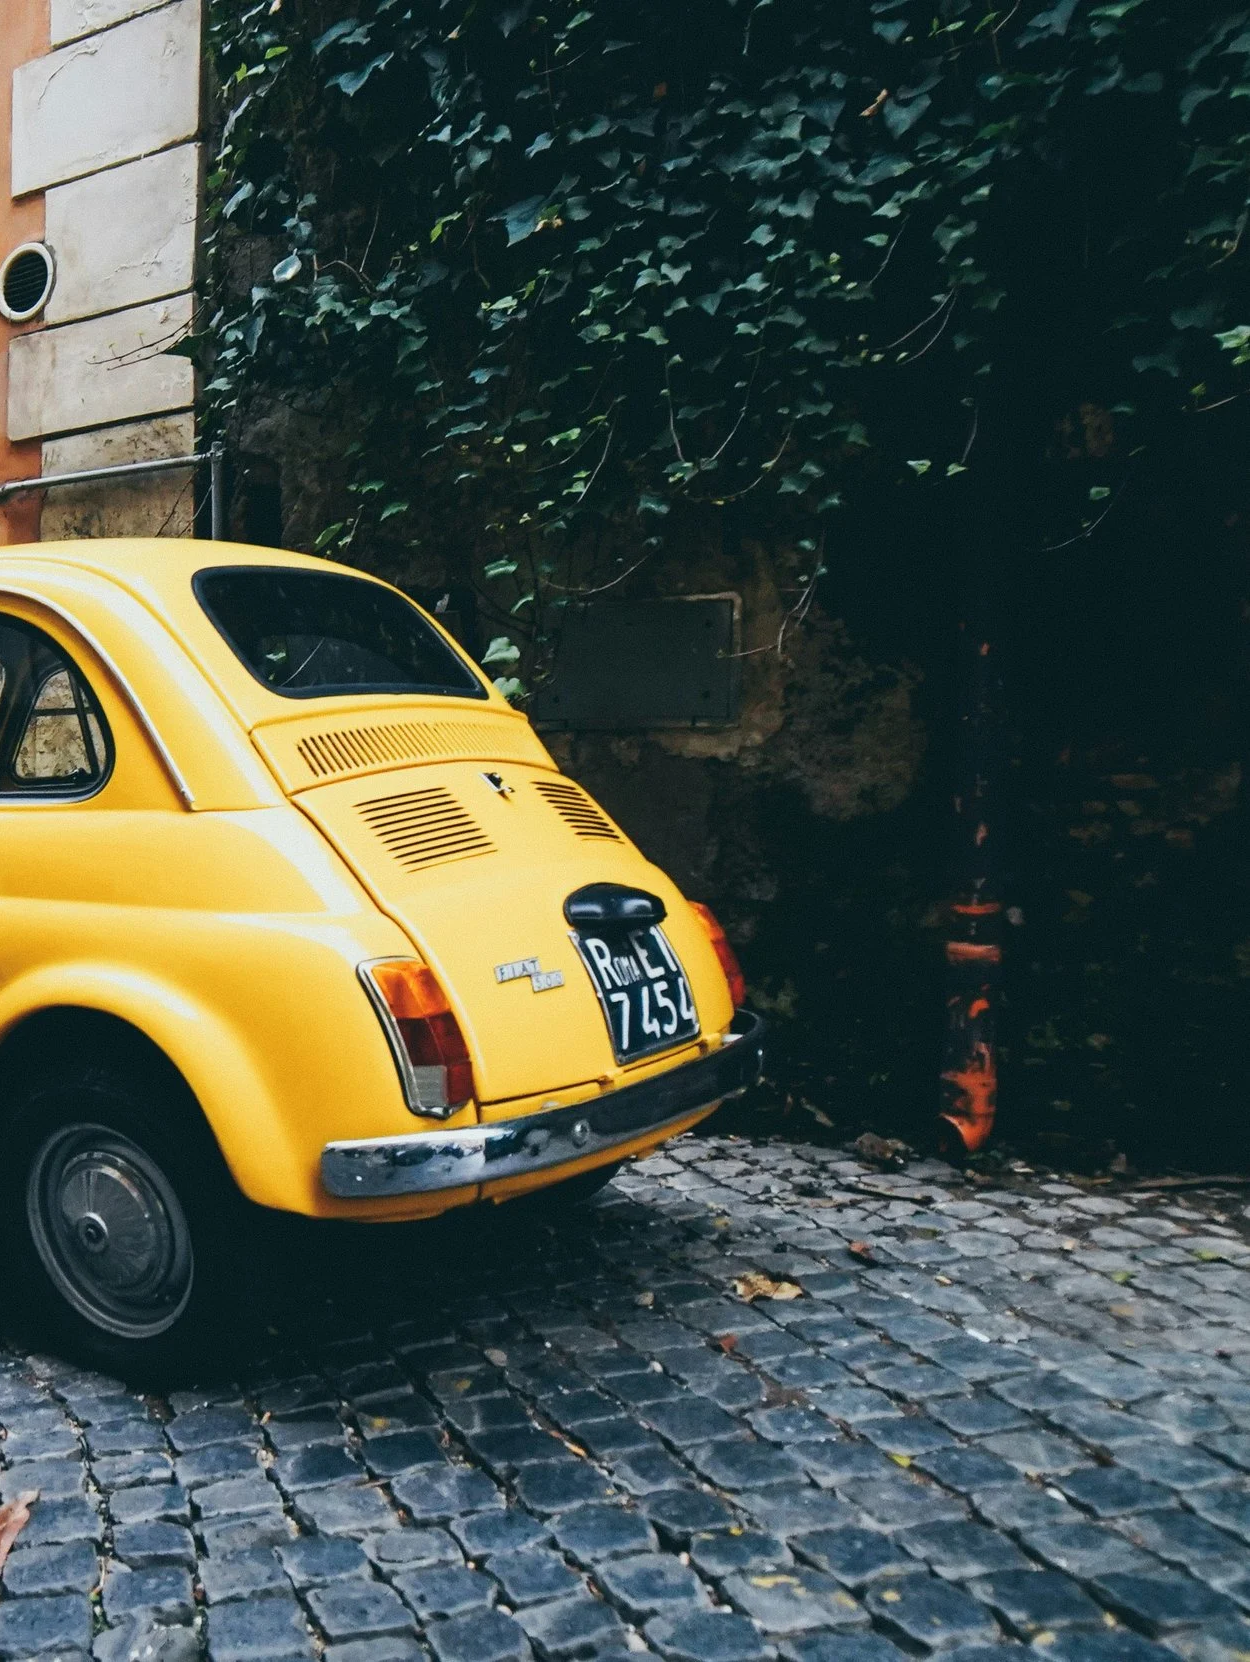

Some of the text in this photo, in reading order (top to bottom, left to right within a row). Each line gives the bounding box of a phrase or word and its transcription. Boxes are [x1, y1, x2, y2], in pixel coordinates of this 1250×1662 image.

[498, 959, 537, 982] FIAT
[534, 972, 562, 989] 500
[609, 976, 696, 1051] 7454
